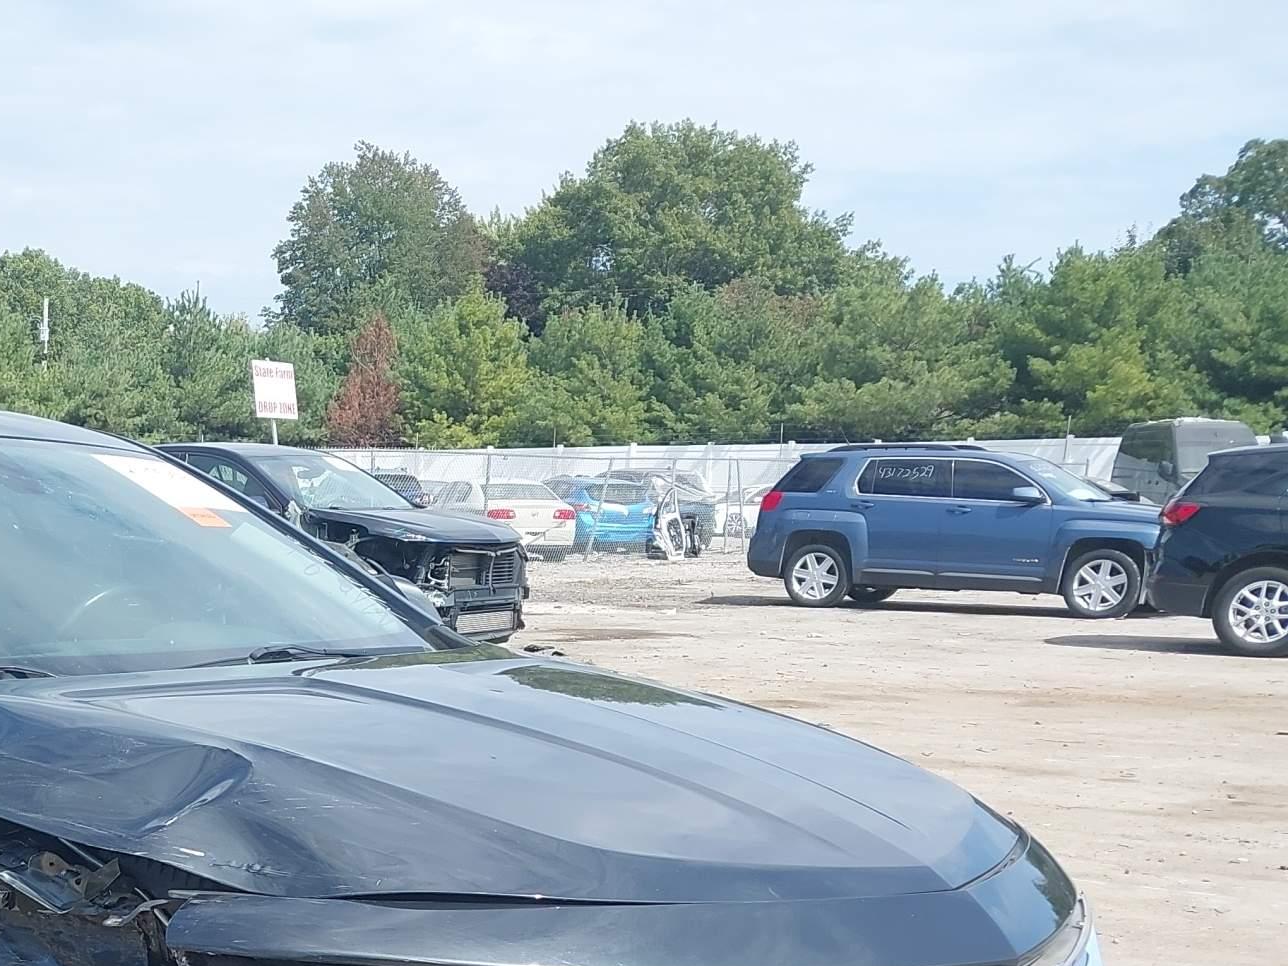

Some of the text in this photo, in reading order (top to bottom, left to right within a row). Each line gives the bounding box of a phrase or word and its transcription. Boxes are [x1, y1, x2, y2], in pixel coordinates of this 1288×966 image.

[254, 365, 293, 380] State Farm
[258, 400, 296, 416] DROP ZONE
